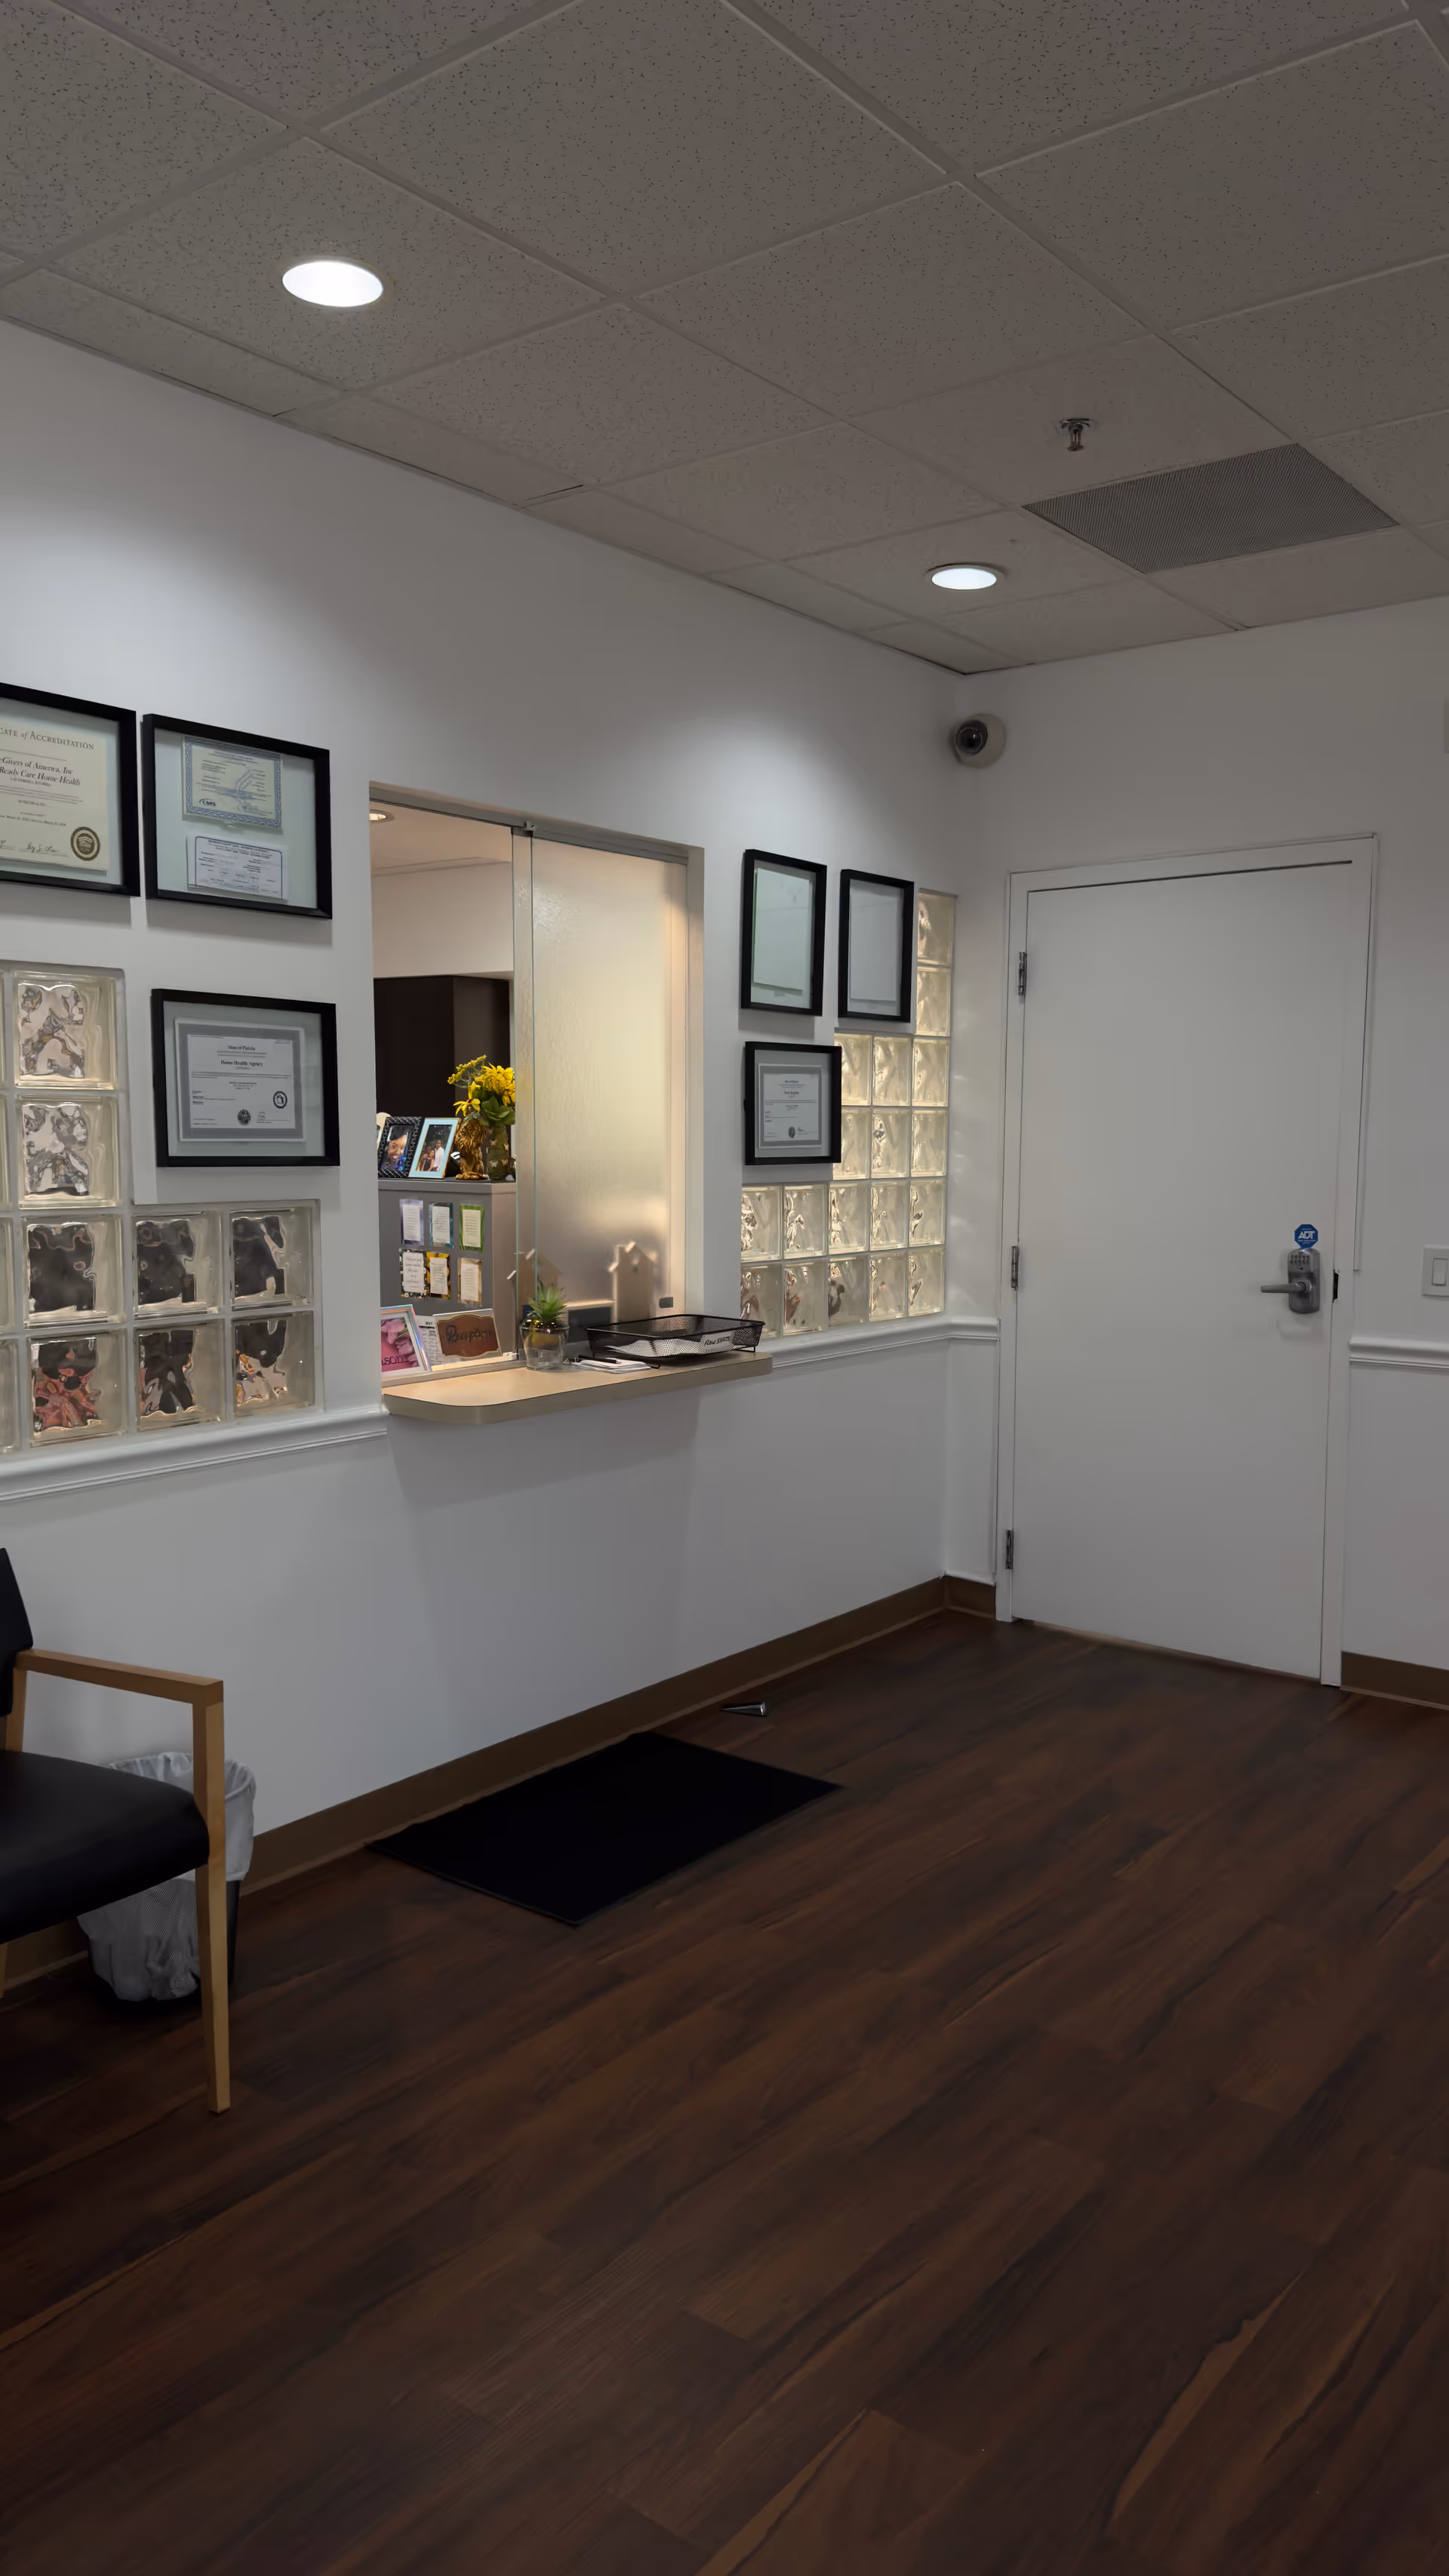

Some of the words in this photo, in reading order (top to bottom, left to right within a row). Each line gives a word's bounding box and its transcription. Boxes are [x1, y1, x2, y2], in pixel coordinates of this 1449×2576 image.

[30, 731, 94, 749] ACCREDITATION
[0, 756, 23, 767] Givers
[20, 770, 36, 779] Care
[38, 773, 58, 782] Home
[59, 776, 81, 786] Health
[1298, 1231, 1315, 1239] ADT
[382, 1356, 404, 1365] son
